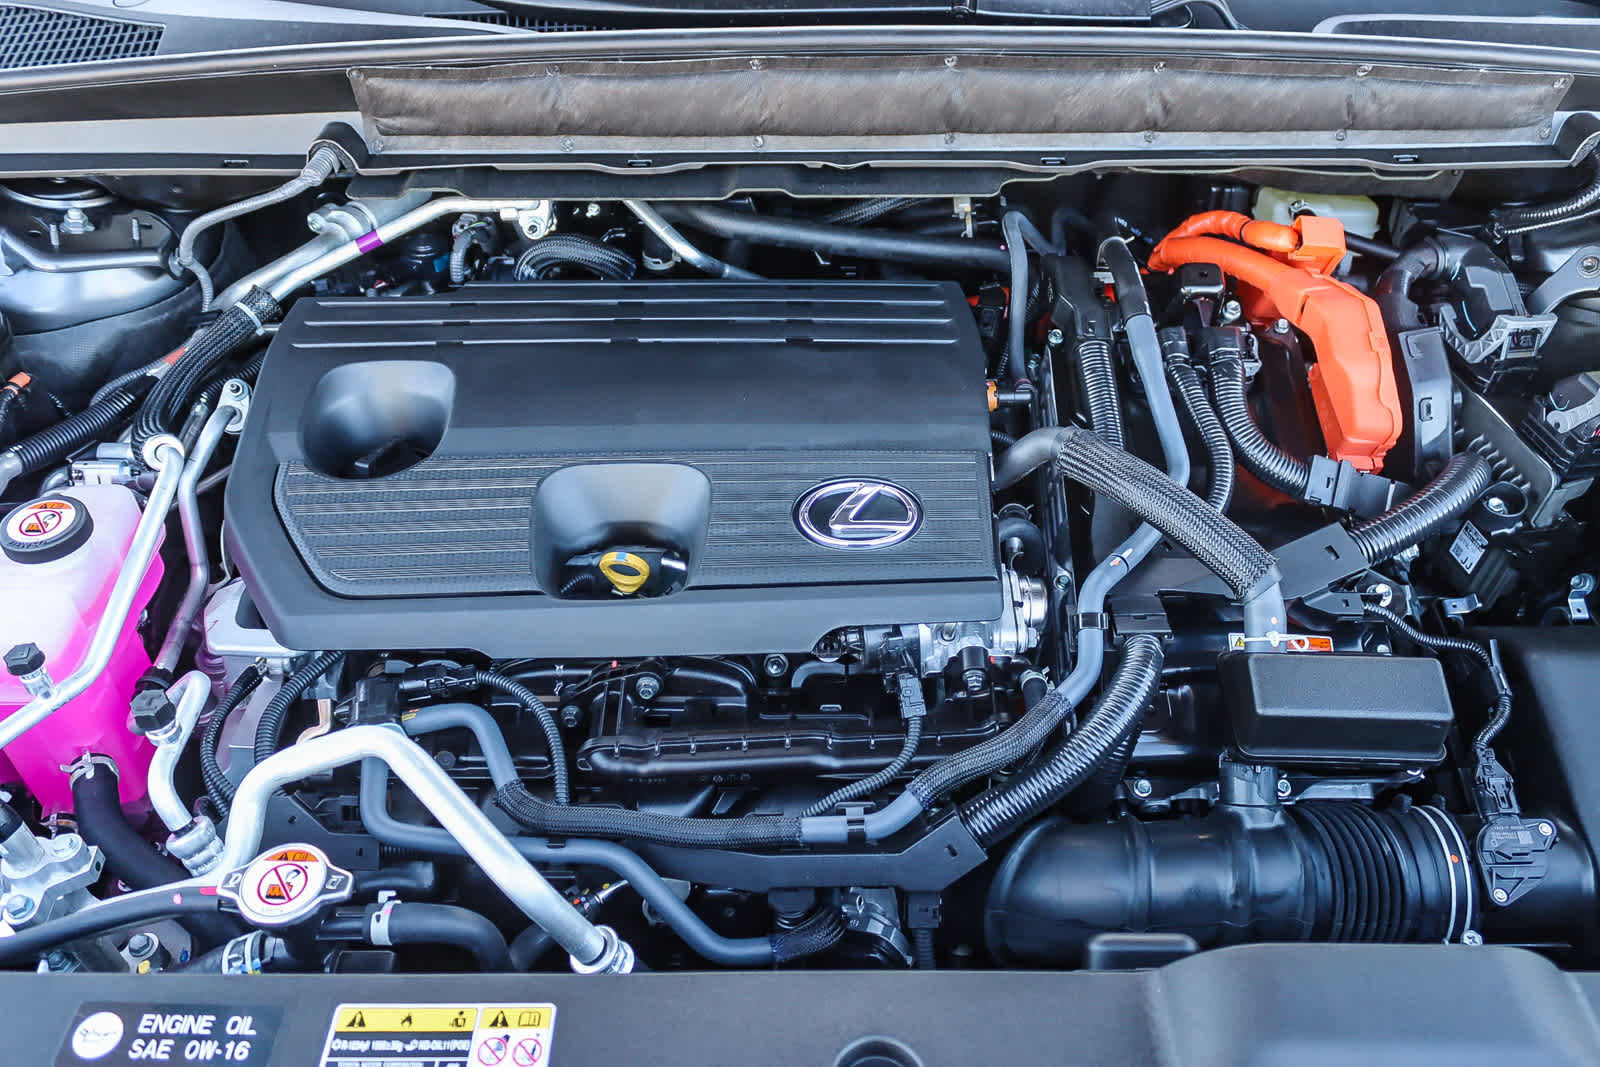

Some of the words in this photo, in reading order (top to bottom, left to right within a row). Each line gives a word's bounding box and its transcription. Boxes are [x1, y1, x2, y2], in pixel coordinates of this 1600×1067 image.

[137, 1013, 216, 1035] ENGINE
[225, 1015, 257, 1036] OIL
[127, 1038, 175, 1060] SAE
[184, 1039, 251, 1061] 0W-16
